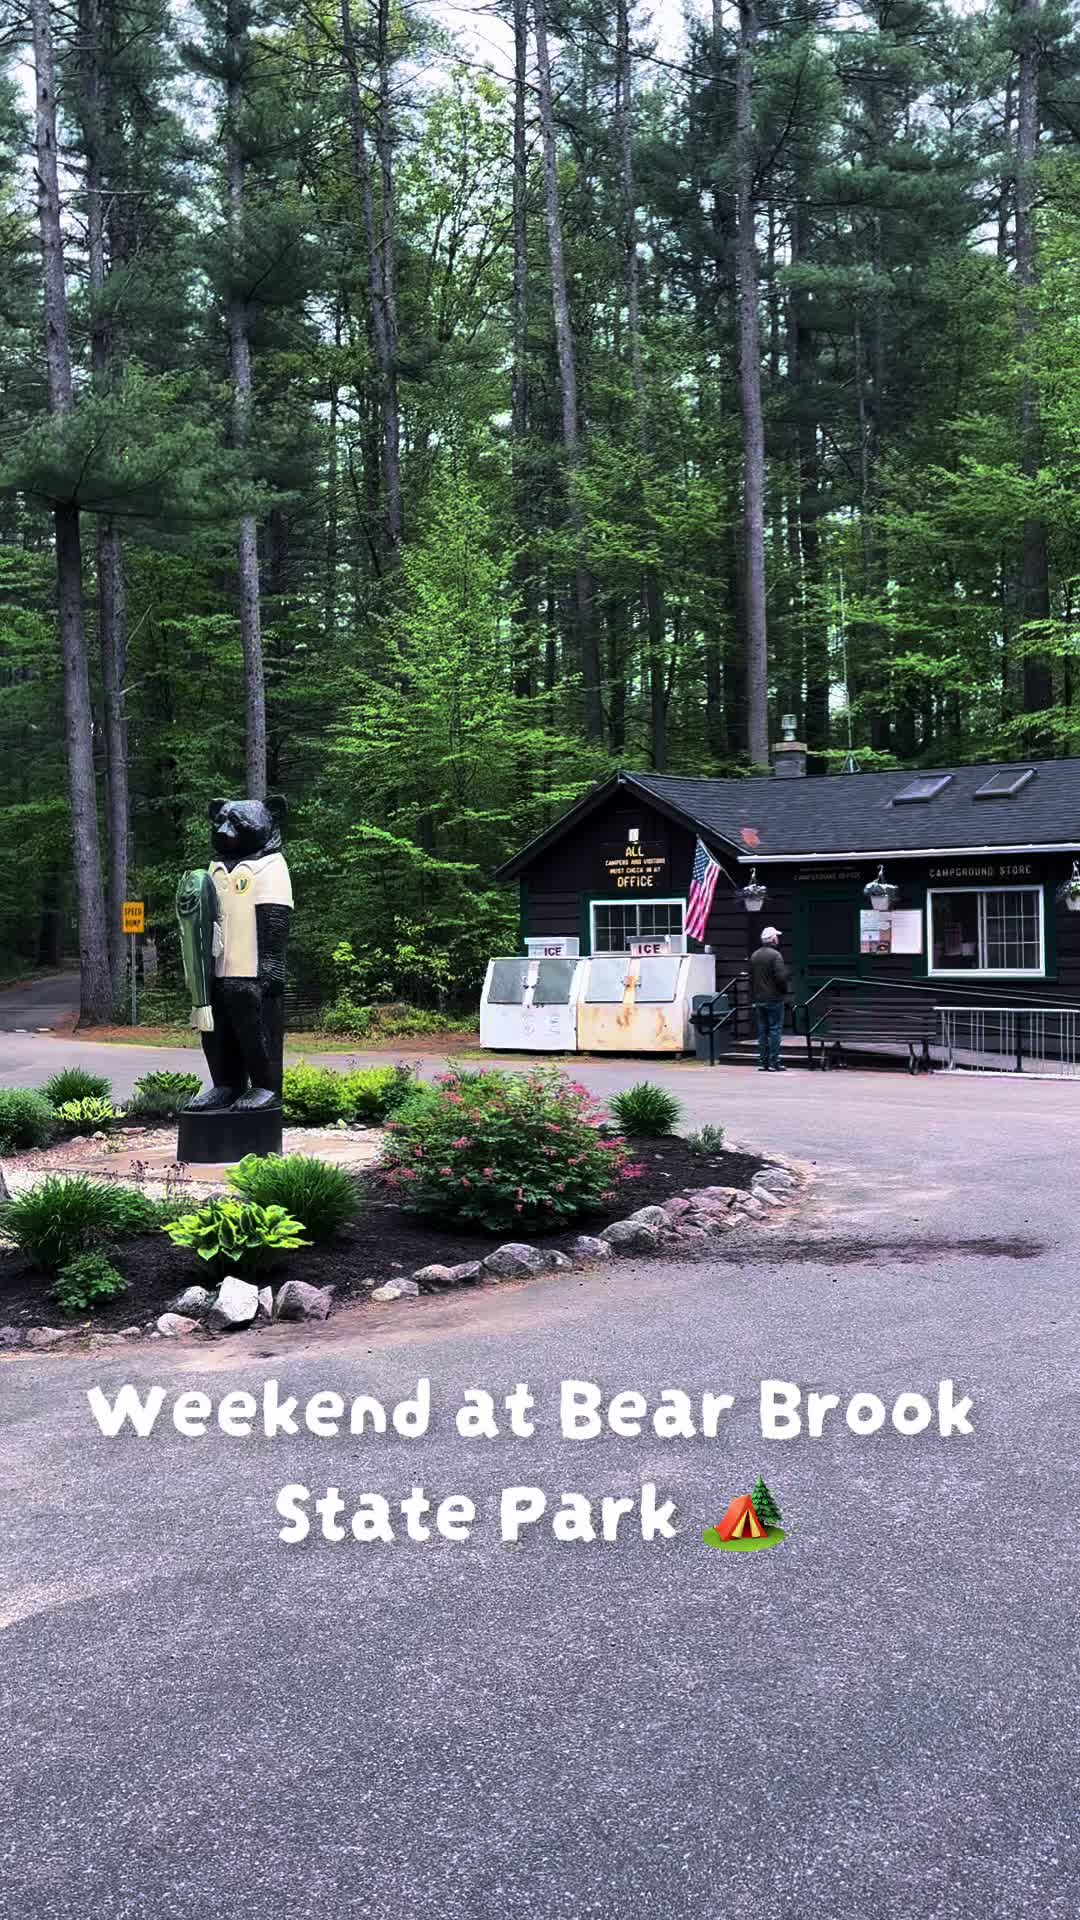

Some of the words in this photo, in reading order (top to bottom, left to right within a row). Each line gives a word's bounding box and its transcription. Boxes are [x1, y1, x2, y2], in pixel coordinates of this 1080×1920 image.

[625, 846, 645, 857] ALL
[928, 865, 993, 878] CAMPGROUND
[999, 864, 1032, 876] STORE
[617, 875, 654, 888] OFFICE
[544, 946, 562, 957] ICE
[637, 943, 661, 955] ICE
